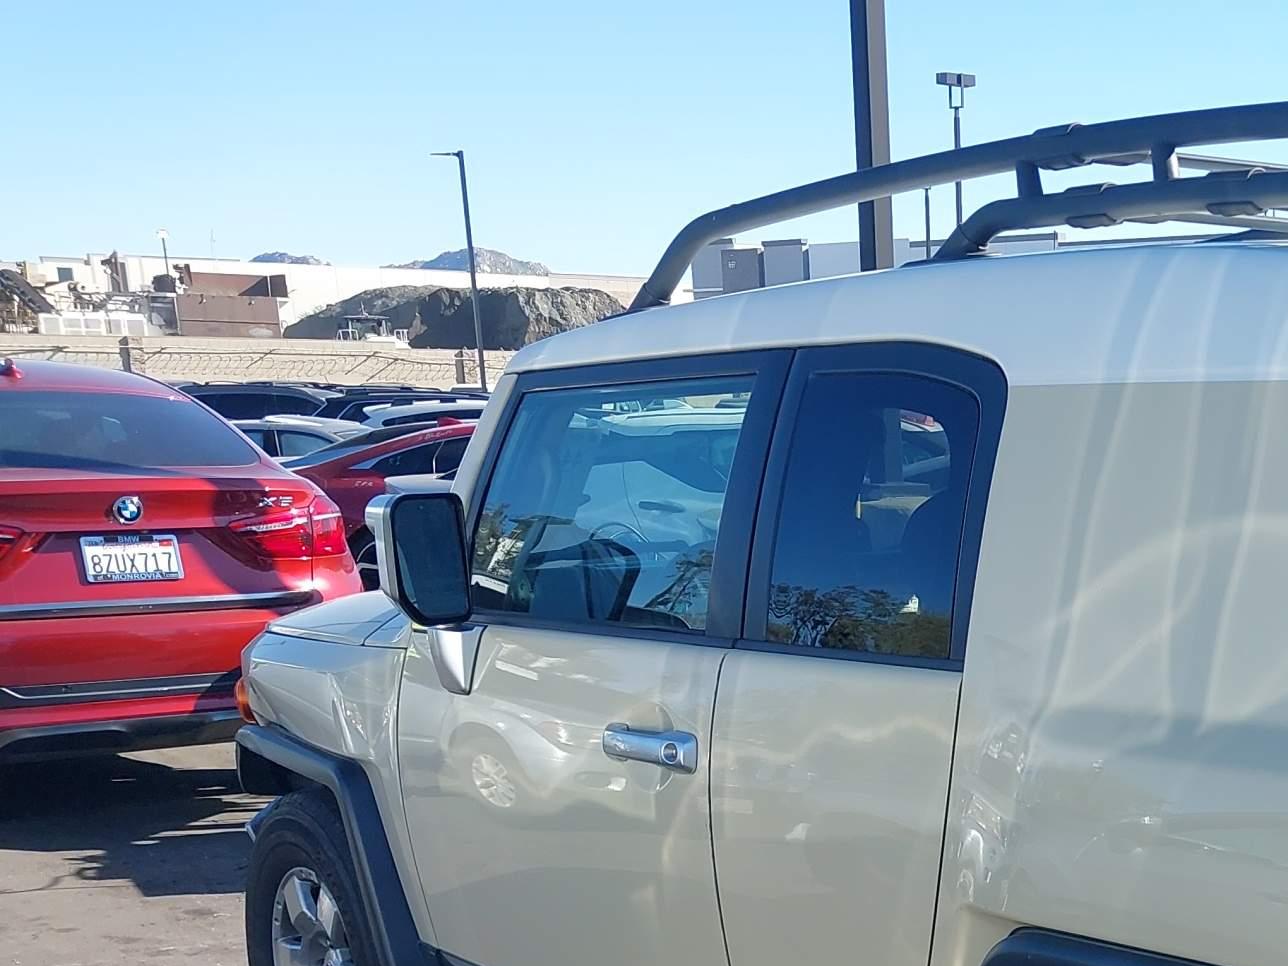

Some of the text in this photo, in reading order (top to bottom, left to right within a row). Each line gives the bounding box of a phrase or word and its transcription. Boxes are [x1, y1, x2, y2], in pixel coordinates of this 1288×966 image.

[117, 535, 140, 543] BMW
[91, 552, 172, 574] 8ZUX717
[112, 572, 163, 581] MONROVIA
